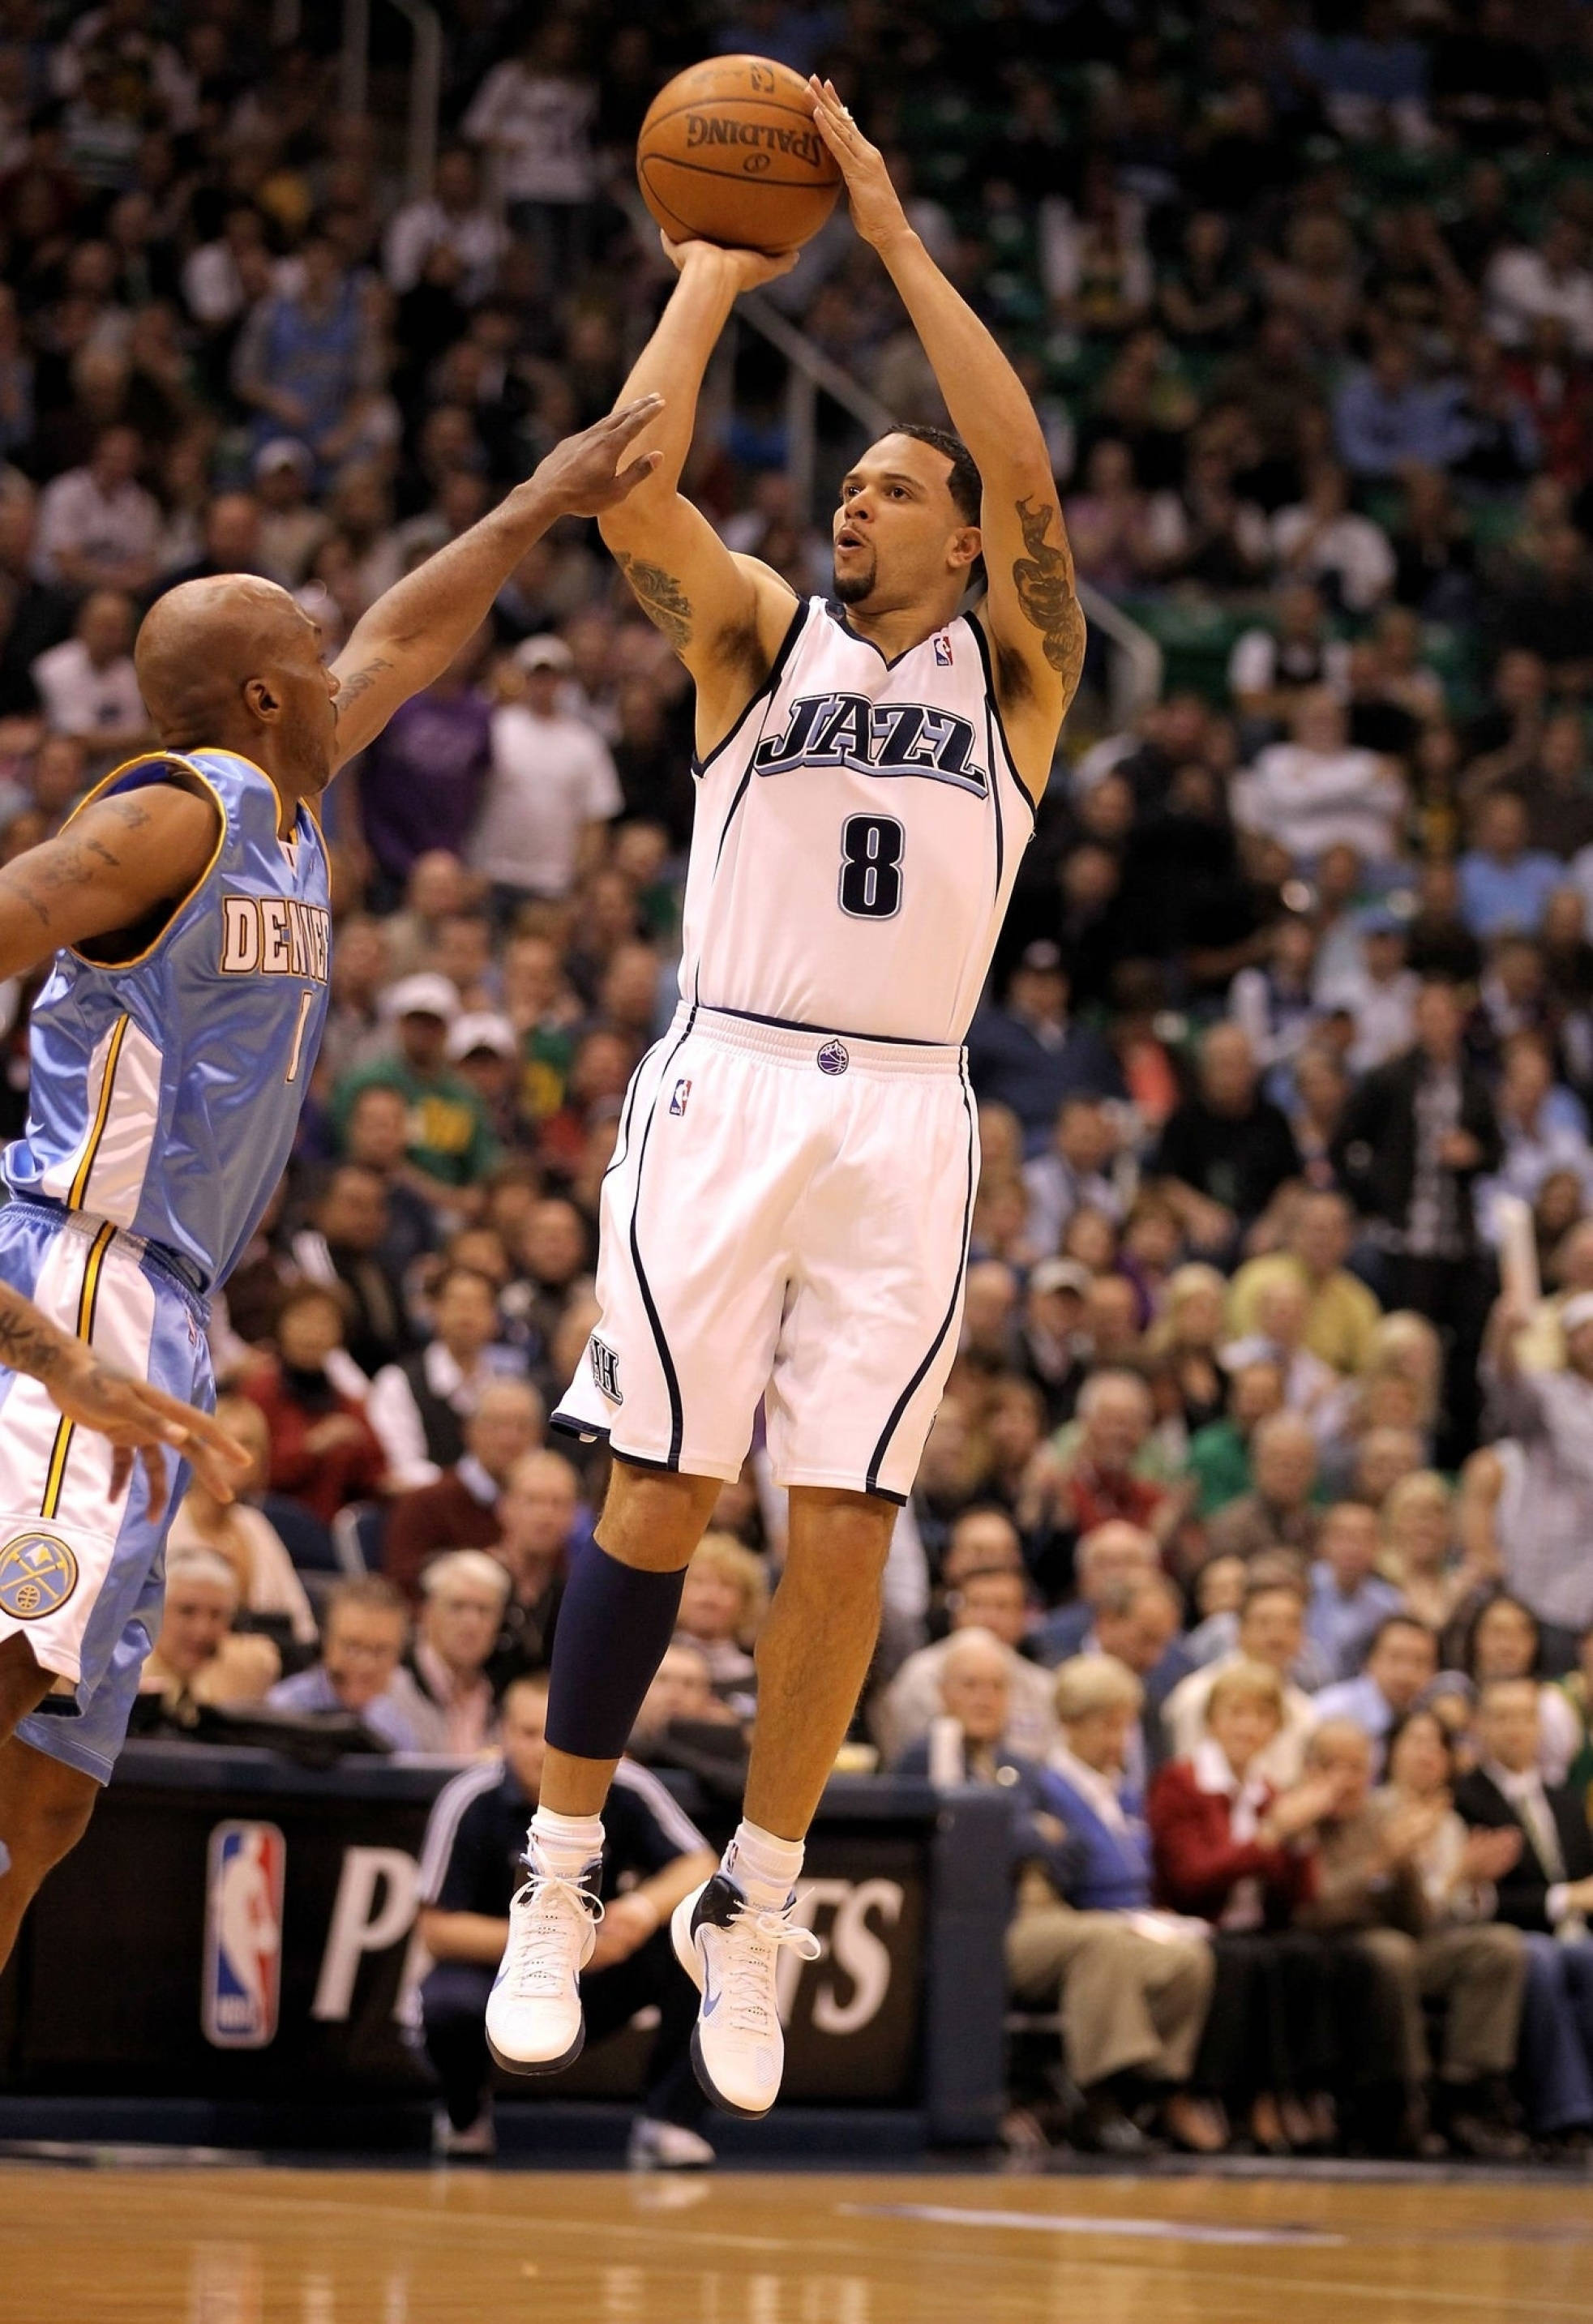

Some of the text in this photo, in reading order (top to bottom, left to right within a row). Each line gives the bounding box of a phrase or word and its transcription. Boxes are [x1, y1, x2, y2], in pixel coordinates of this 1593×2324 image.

[687, 114, 822, 168] SPALDING
[753, 691, 989, 800] JAZZ
[837, 812, 906, 922] 8
[285, 990, 315, 1083] 1
